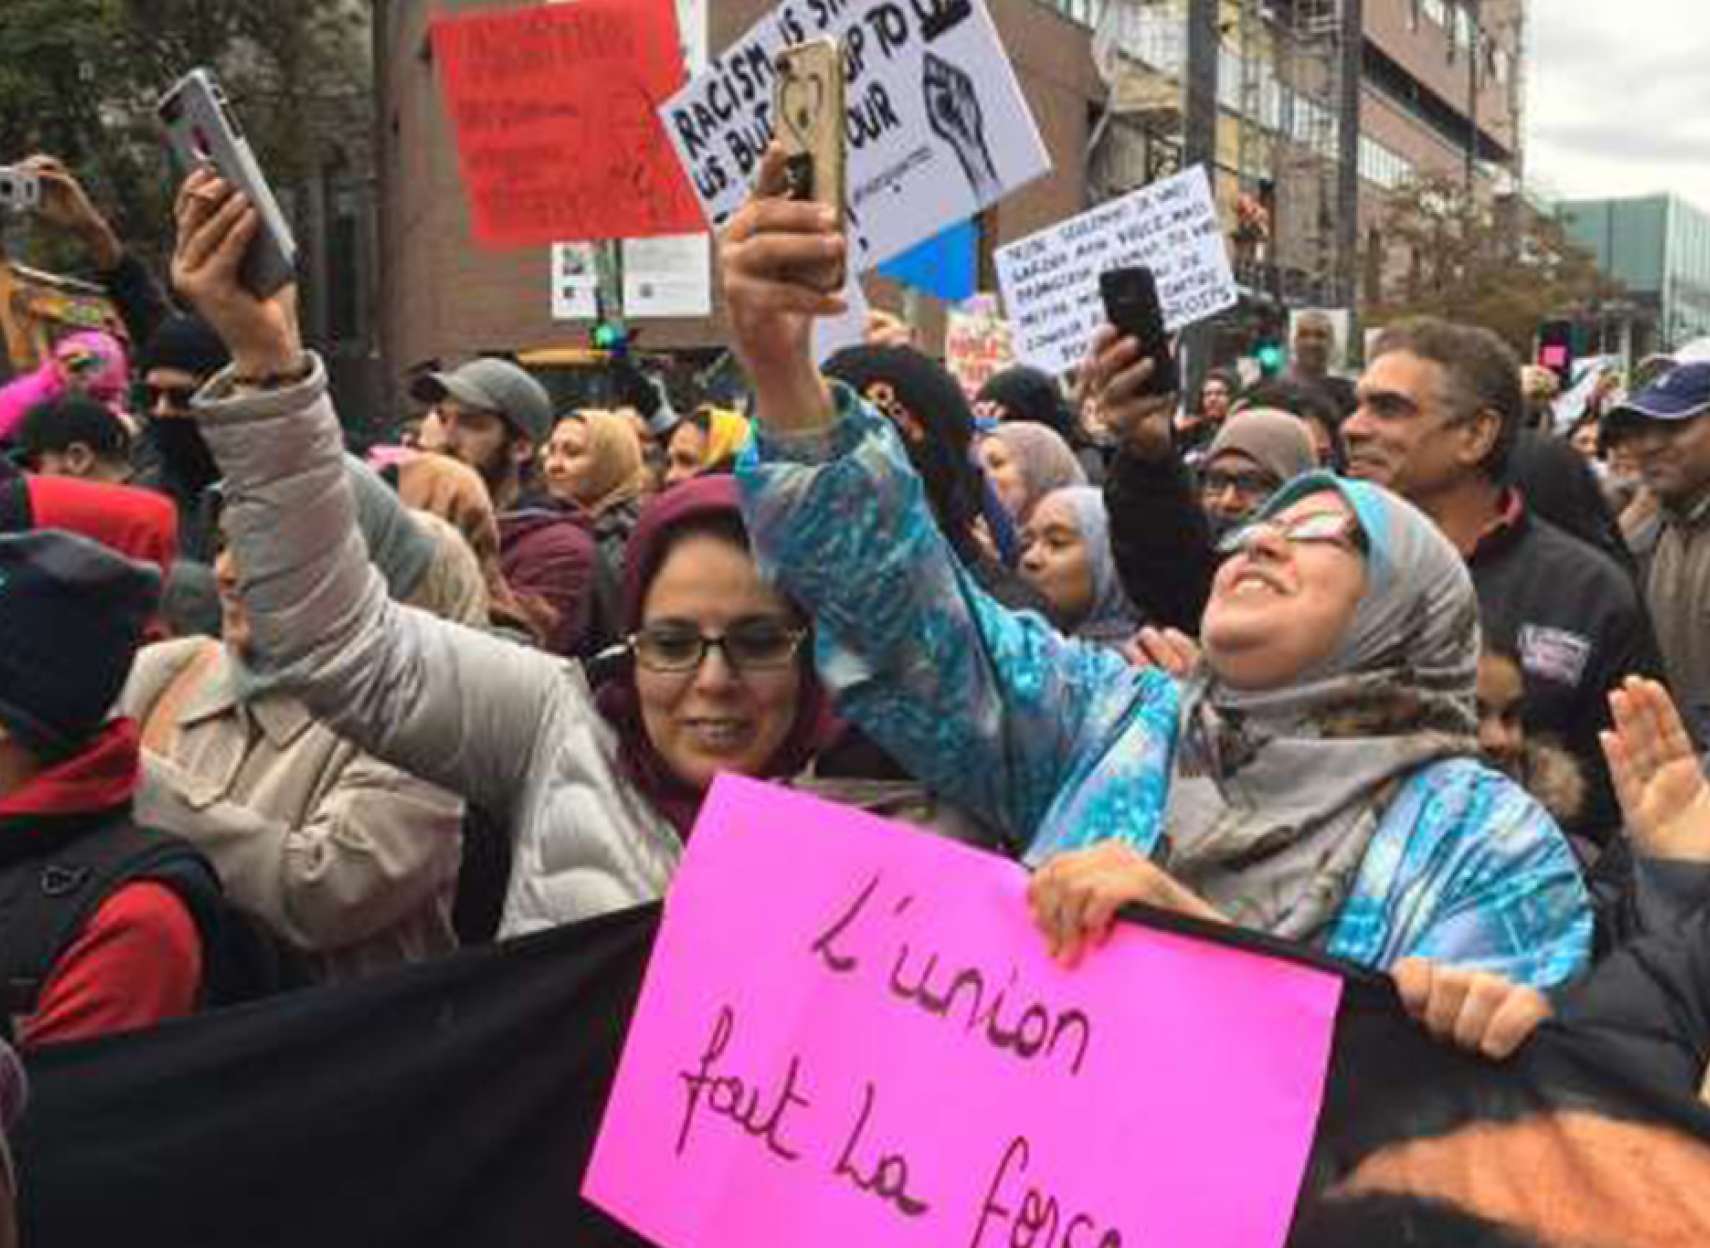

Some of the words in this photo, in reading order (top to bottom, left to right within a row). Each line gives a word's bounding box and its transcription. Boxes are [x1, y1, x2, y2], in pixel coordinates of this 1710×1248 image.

[777, 7, 805, 48] IS
[863, 4, 909, 59] TO
[812, 877, 1090, 1077] L'union
